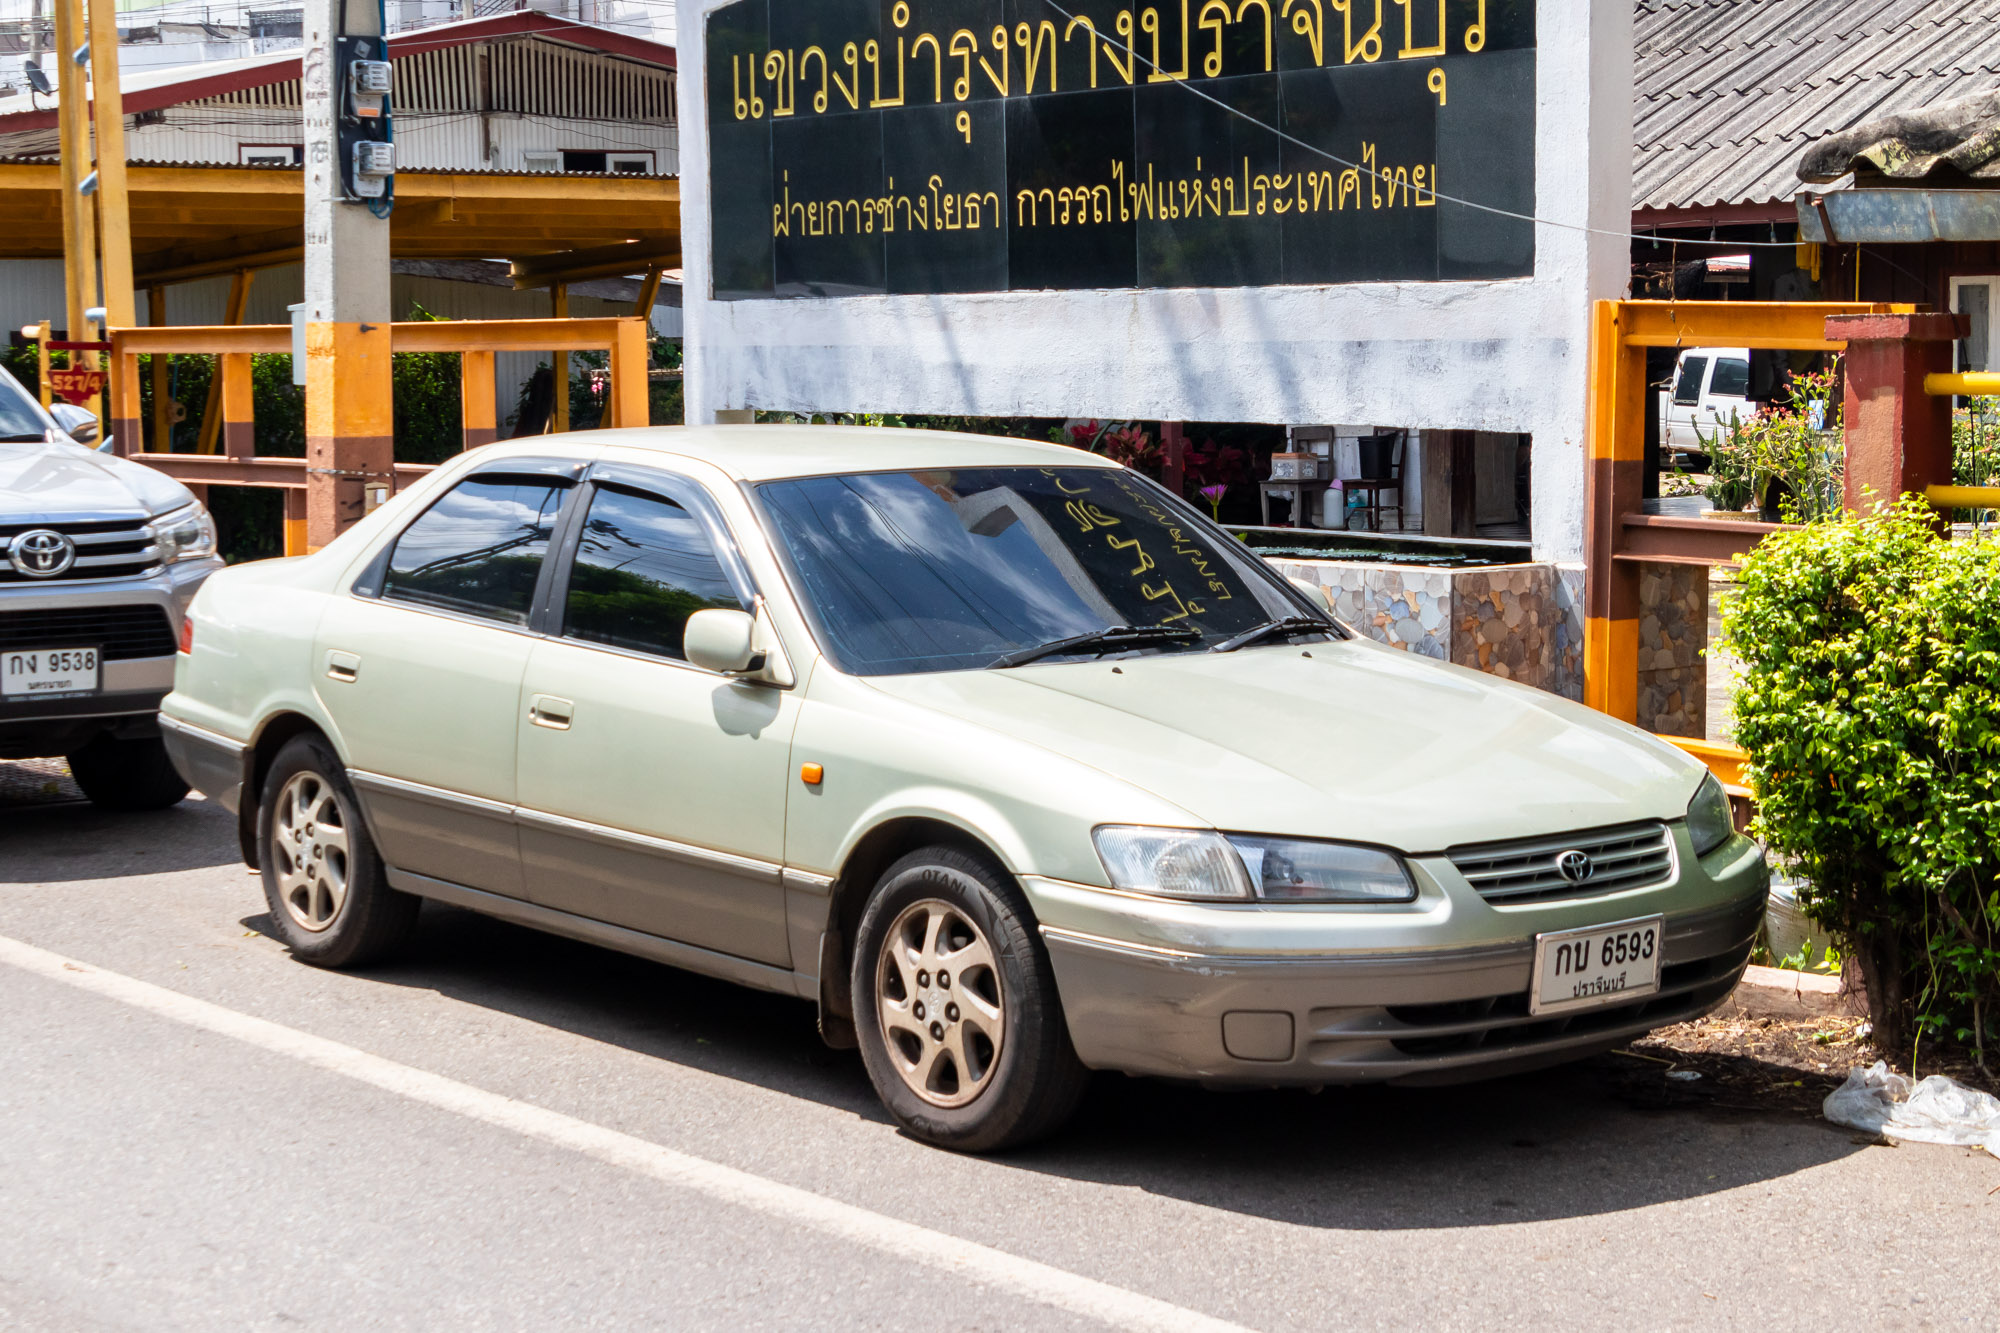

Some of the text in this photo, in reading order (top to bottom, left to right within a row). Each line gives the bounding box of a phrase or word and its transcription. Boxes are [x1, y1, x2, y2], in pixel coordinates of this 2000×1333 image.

[733, 0, 1487, 144] แขวงบำรุงทางปราจนบุร
[773, 141, 1437, 237] ฝ่ายการช่างโยธา การรถไฟแห่งประเทศไทย
[52, 373, 101, 393] 527/4
[10, 651, 96, 675] กง 9538
[922, 868, 967, 897] OTANI
[1555, 928, 1655, 976] กบ 6593
[1573, 971, 1627, 997] ปราจีนบรี
